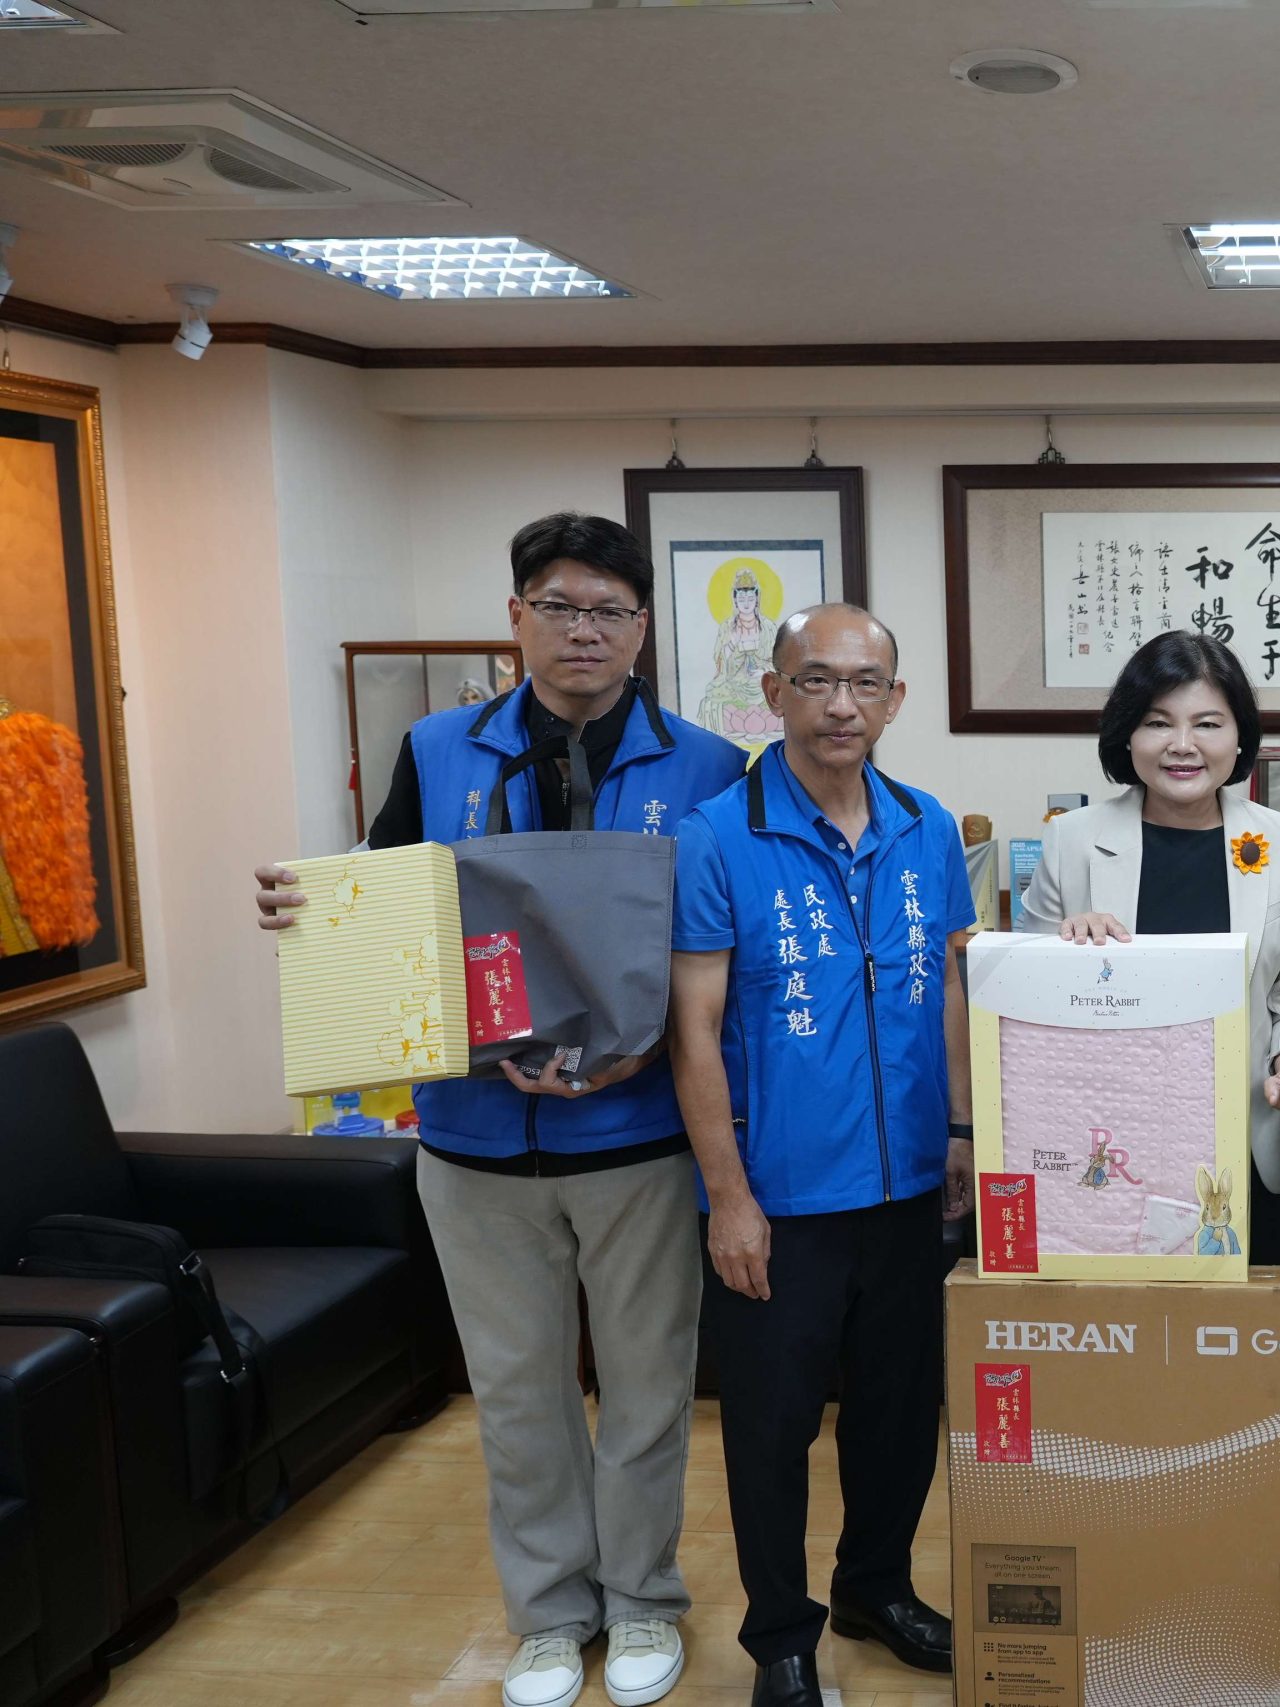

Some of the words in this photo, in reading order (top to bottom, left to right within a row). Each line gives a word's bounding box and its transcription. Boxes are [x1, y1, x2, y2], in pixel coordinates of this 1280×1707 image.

[464, 790, 481, 839] 科長
[803, 883, 838, 959] 民政處
[900, 869, 930, 1005] 雲林縣政府
[1070, 995, 1103, 1006] PETER
[1105, 995, 1141, 1007] RABBIT
[1033, 1149, 1067, 1160] PETER
[1001, 1207, 1016, 1259] 張麗善
[984, 1320, 1138, 1354] HERAN
[996, 1396, 1011, 1449] 張麗善
